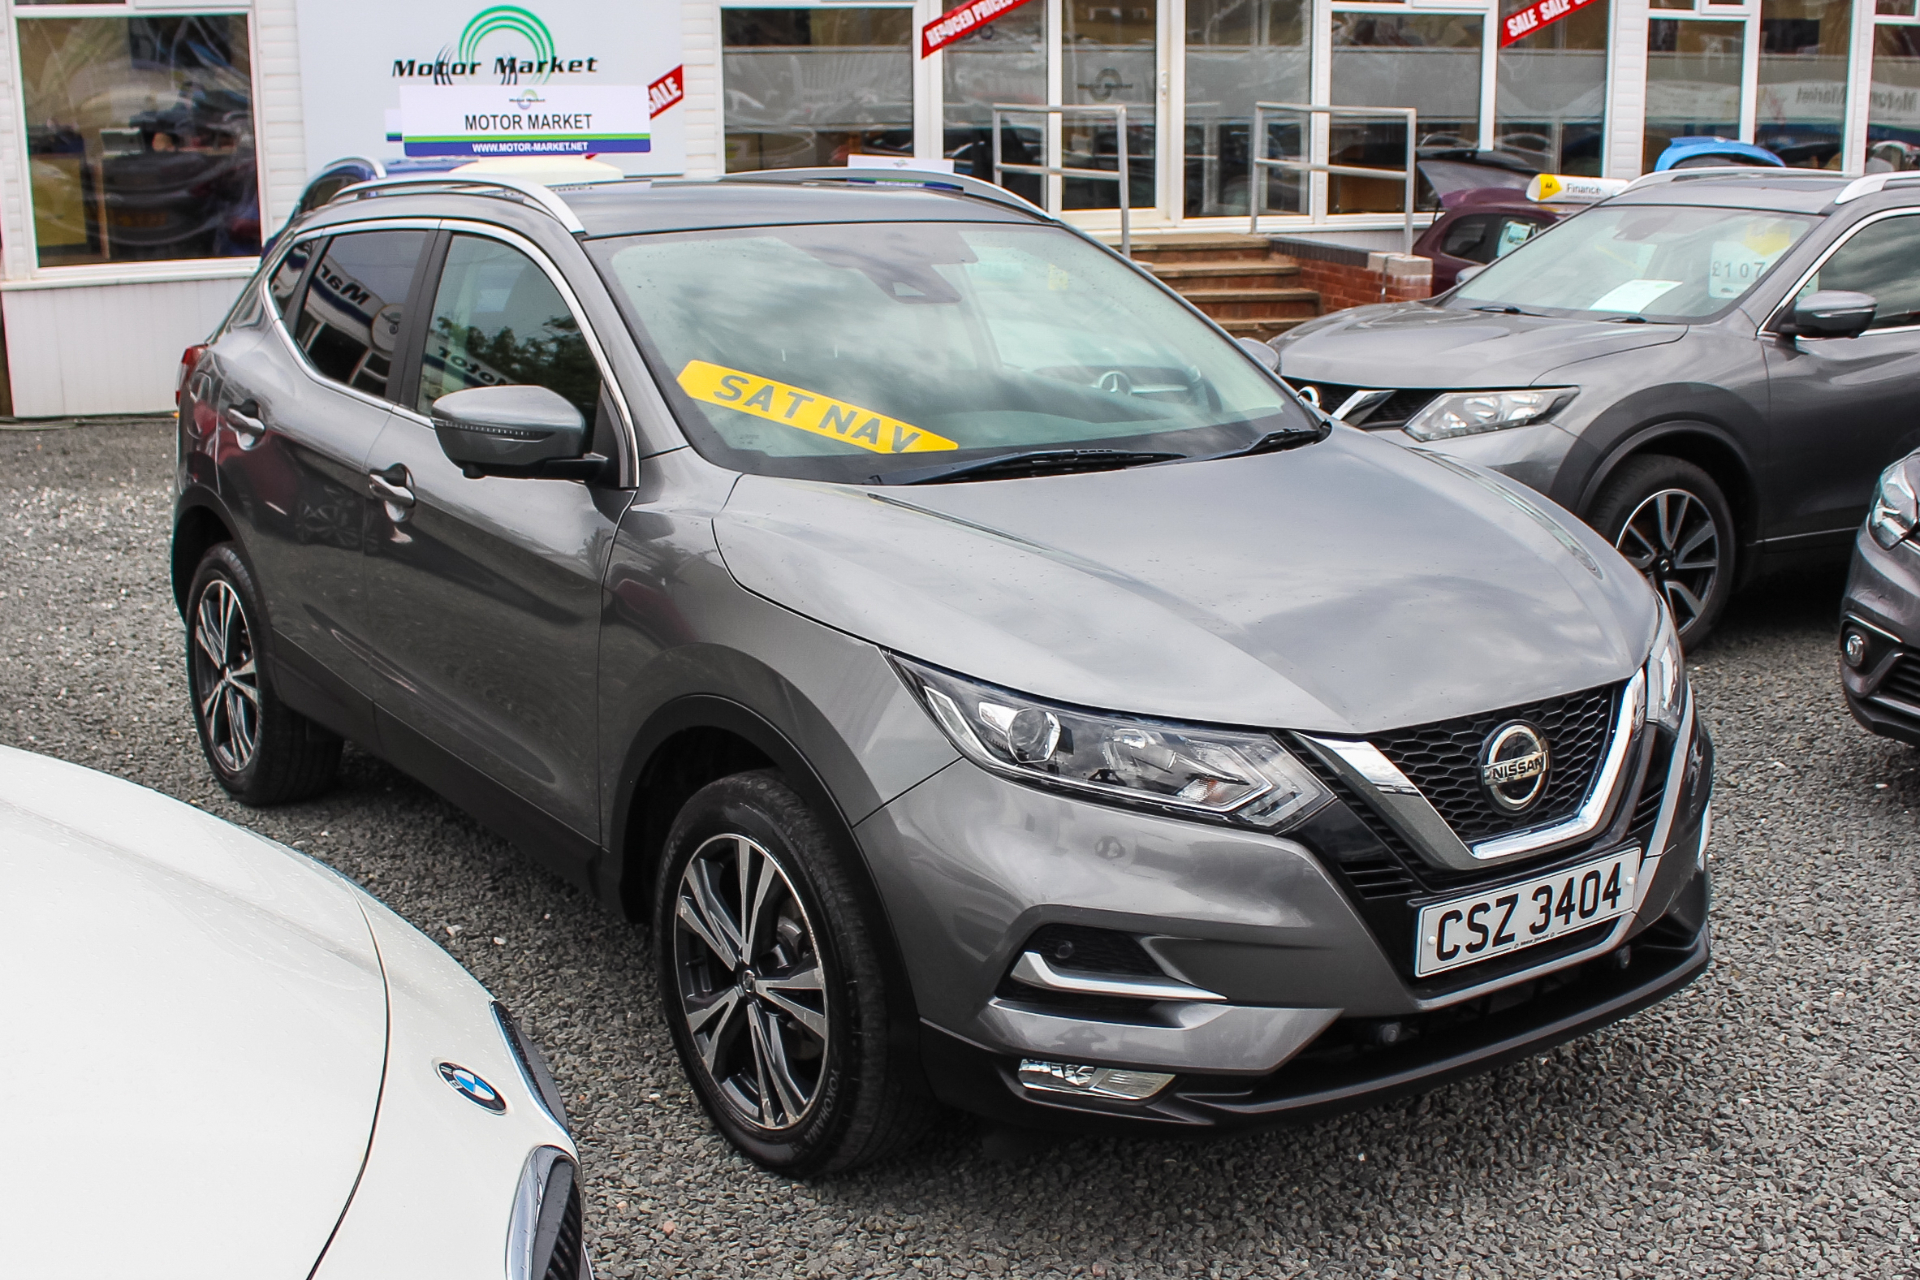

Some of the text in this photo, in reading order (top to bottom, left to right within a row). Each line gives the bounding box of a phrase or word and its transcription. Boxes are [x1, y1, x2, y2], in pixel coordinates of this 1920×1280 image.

[1507, 0, 1571, 37] SALE SALE
[392, 56, 598, 77] Motor Market
[465, 114, 593, 131] MOTOR MARKET
[472, 141, 589, 153] WWW.MOTOR-MARKET.NET
[1566, 183, 1602, 195] Finance
[713, 375, 920, 453] SAT NAV
[1493, 757, 1544, 780] NISSAN
[1436, 861, 1622, 962] CSZ 3404
[803, 1068, 840, 1145] YOKOHAMA
